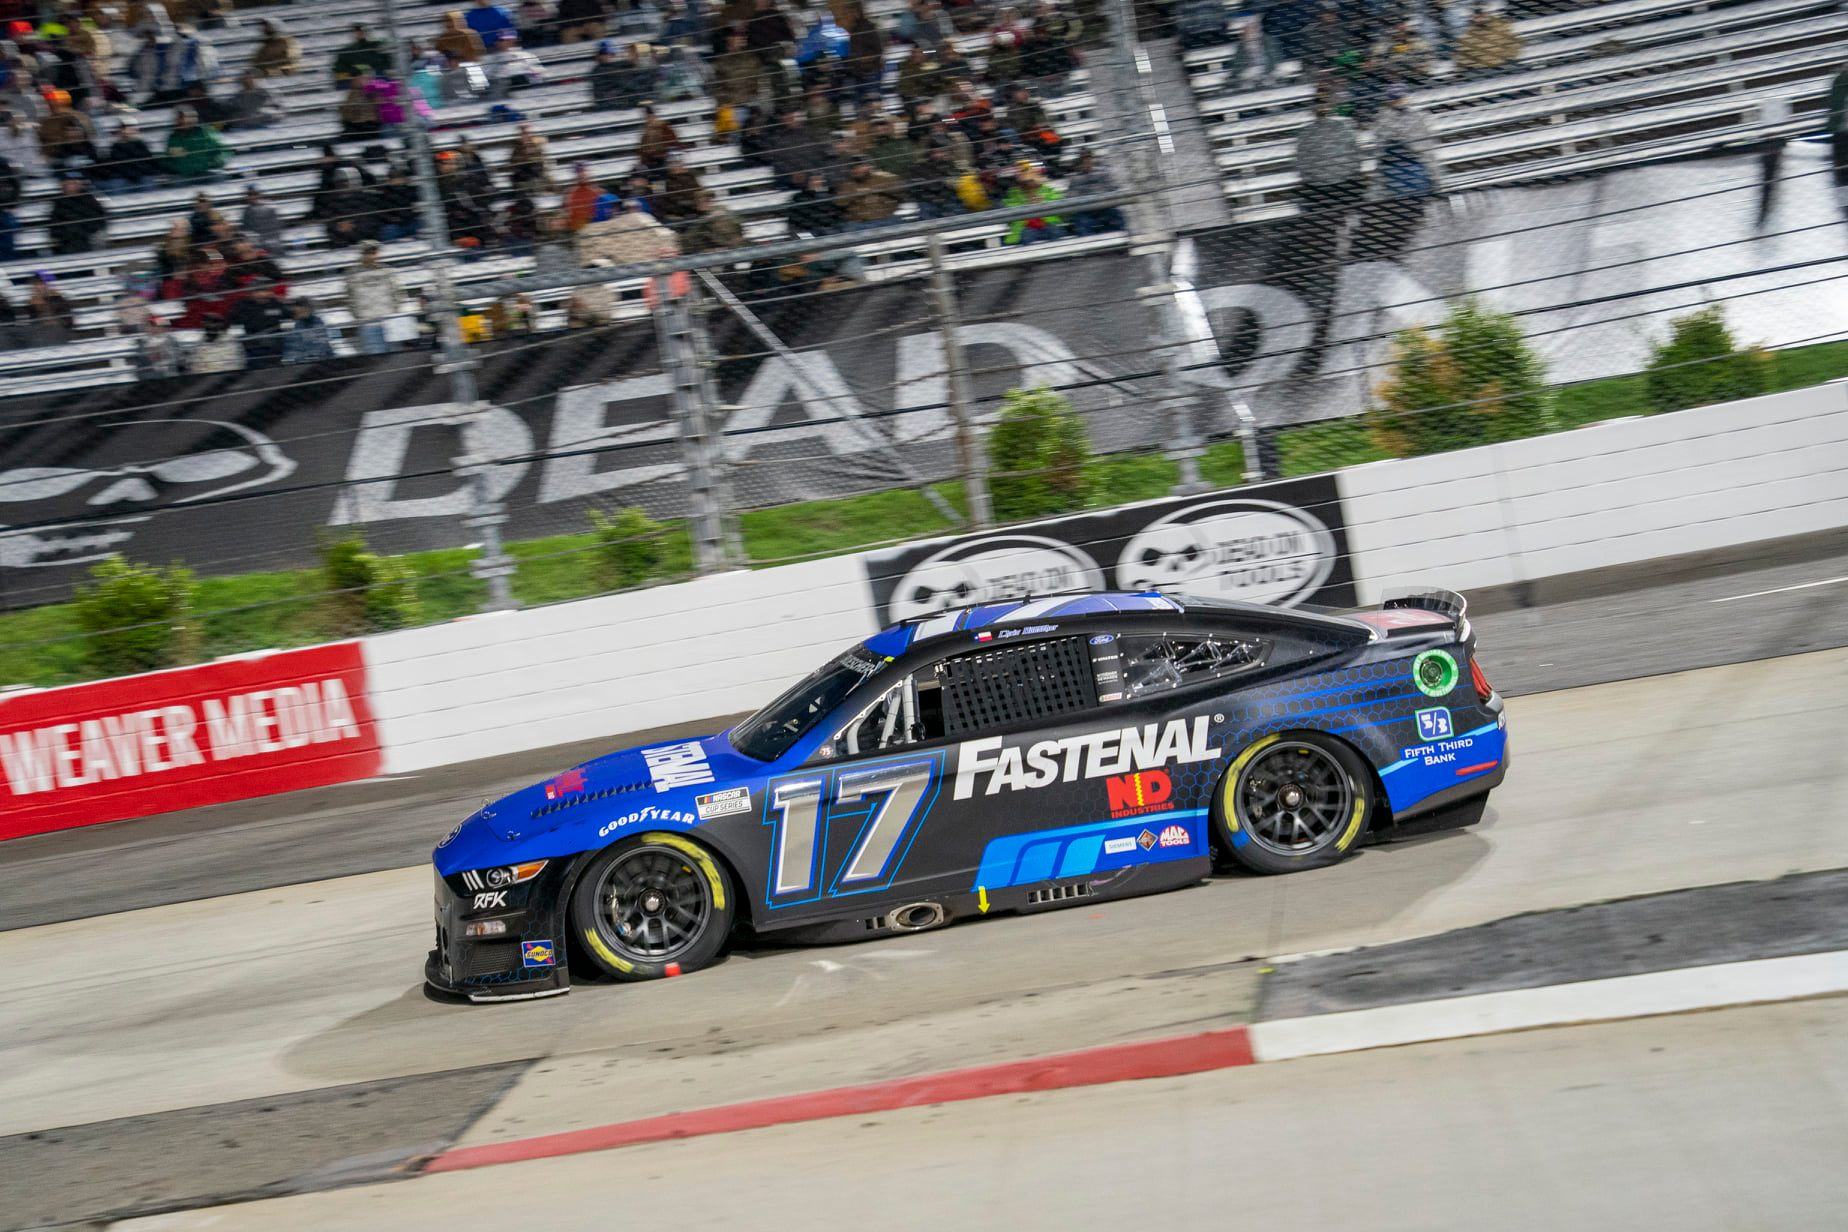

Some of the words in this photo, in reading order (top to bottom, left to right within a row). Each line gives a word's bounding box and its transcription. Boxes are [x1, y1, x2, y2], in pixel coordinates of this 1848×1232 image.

[328, 322, 1082, 526] DEAD
[0, 705, 206, 795] WEAVER
[202, 678, 361, 761] MEDIA
[953, 715, 1222, 800] FASTENAL
[1405, 745, 1435, 759] FIFTH
[1438, 738, 1473, 752] THIRD
[1424, 752, 1456, 766] BANK
[712, 790, 741, 803] NASCAR
[705, 804, 718, 813] CUP
[720, 800, 743, 811] SERIES
[1111, 801, 1175, 819] INDUSTRIES
[598, 806, 695, 837] GOODYEAR
[773, 760, 938, 896] 17
[1160, 825, 1188, 840] MAC
[1160, 838, 1190, 849] TOOLS
[473, 890, 508, 910] RFK
[526, 950, 554, 959] SUNOCO
